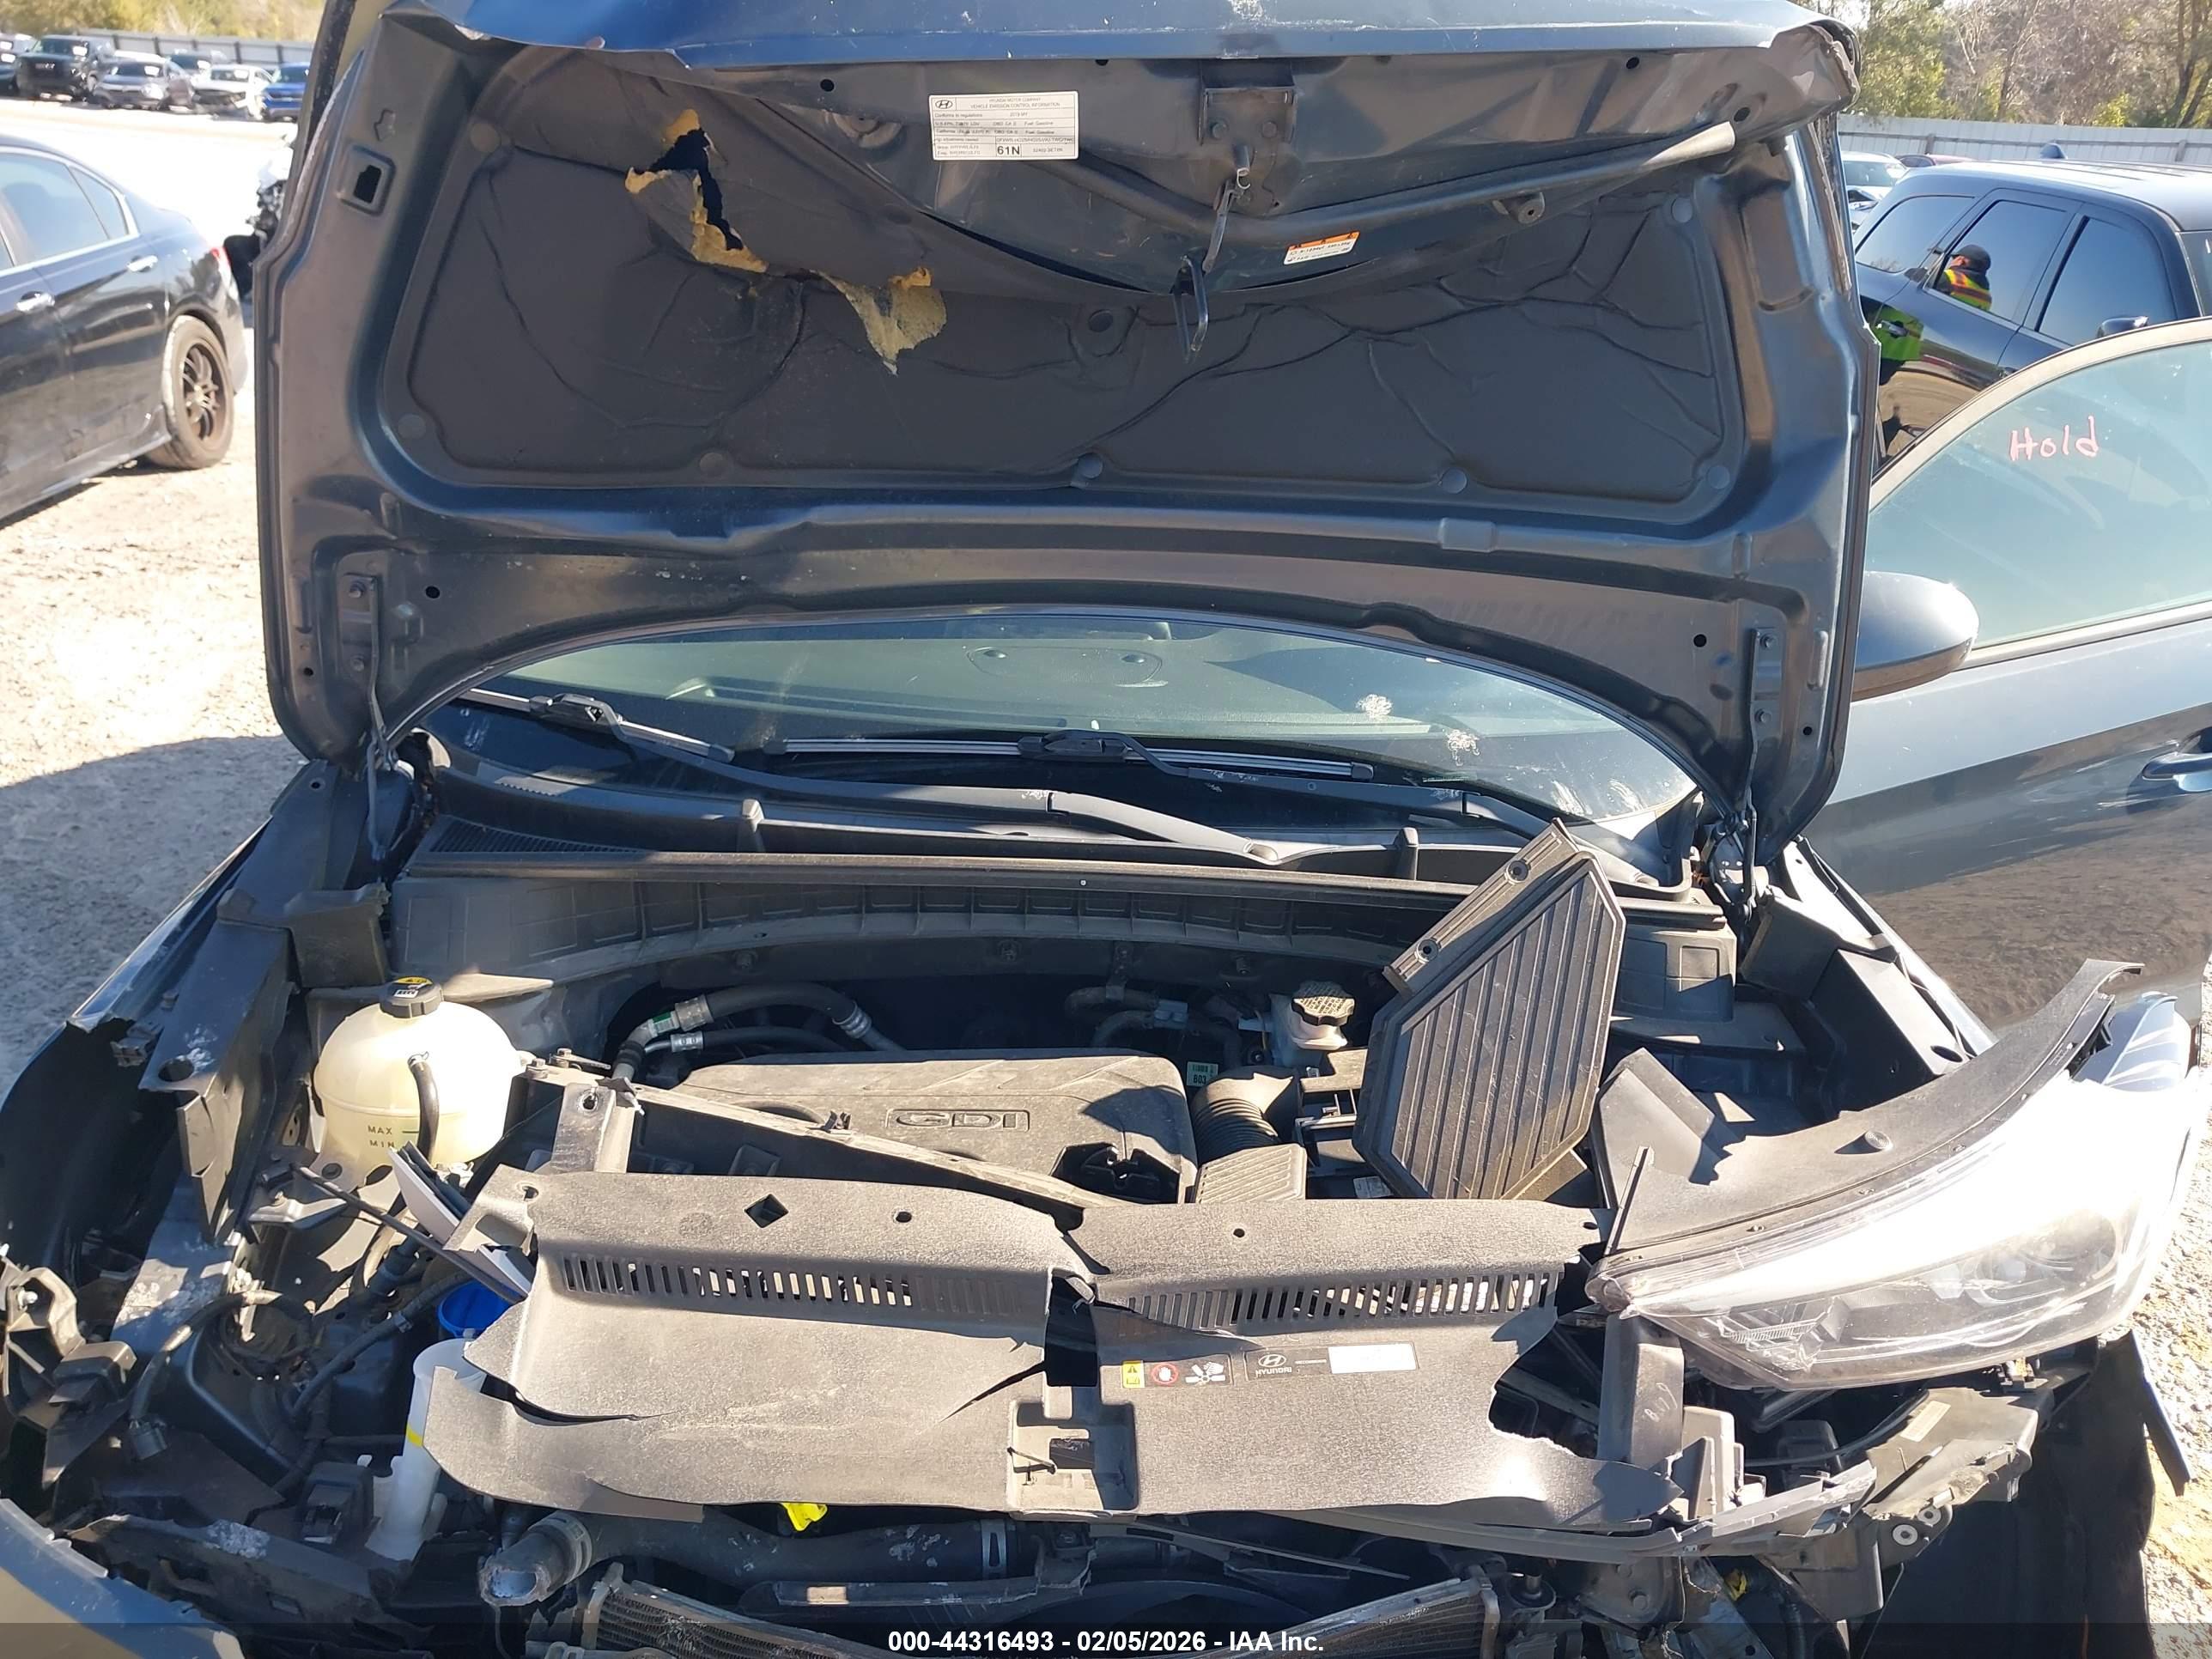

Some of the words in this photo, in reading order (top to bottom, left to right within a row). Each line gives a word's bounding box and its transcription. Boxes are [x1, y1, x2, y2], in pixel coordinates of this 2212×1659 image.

[997, 146, 1020, 155] 61N
[2009, 415, 2099, 461] Hold
[896, 1110, 1018, 1128] GDI
[368, 1125, 392, 1135] MAX
[369, 1139, 395, 1148] MIN
[1255, 1366, 1292, 1376] HYUNDAI
